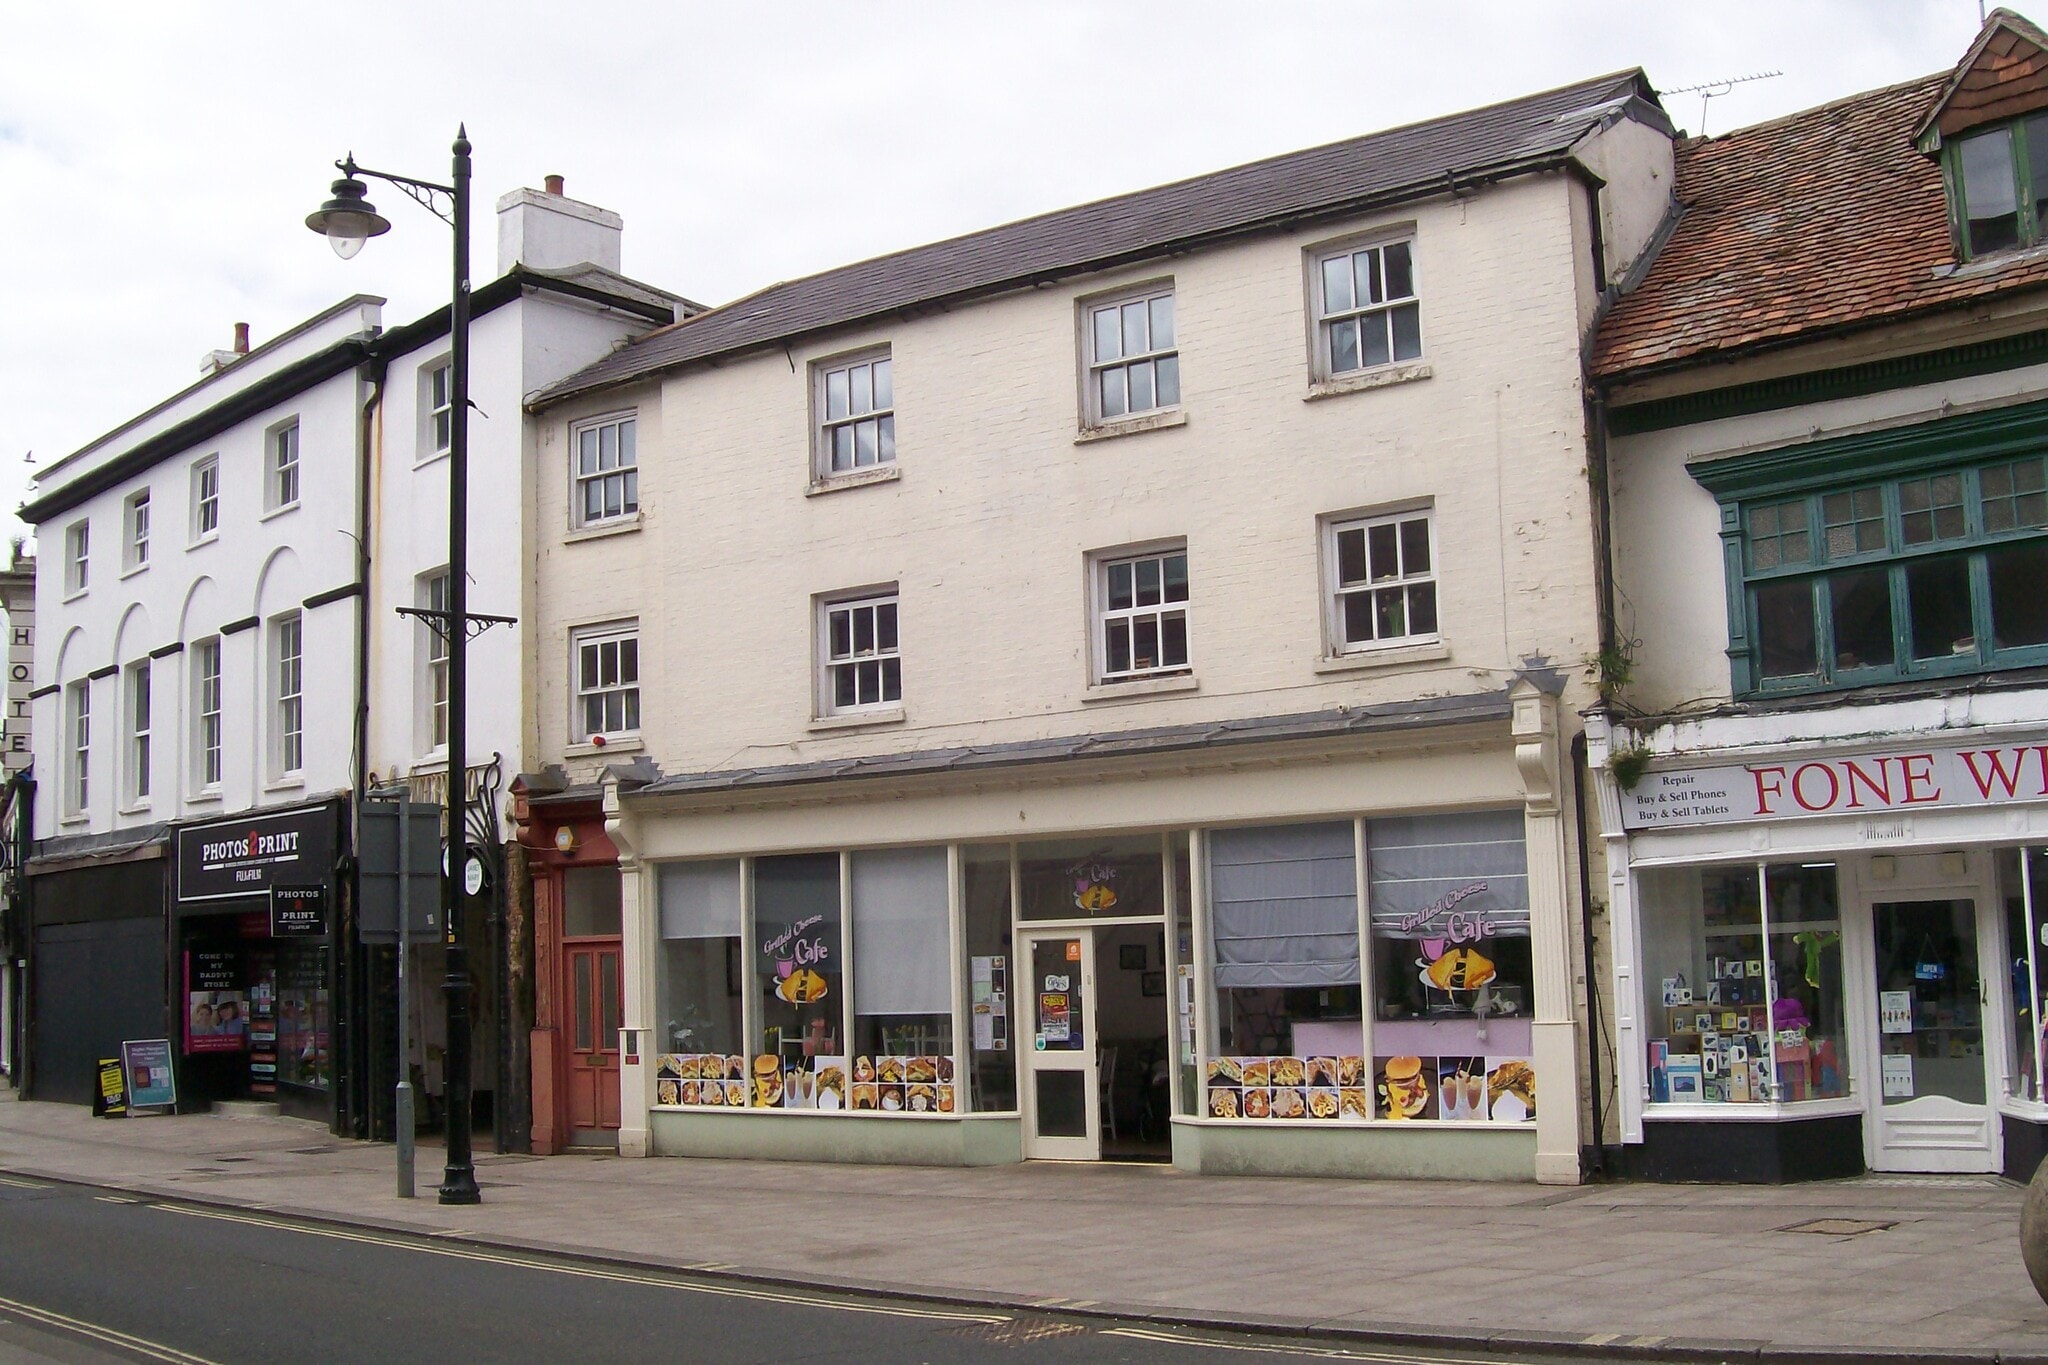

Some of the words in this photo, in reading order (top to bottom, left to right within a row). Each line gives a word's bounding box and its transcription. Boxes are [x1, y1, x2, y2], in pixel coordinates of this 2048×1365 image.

[1662, 774, 1695, 787] Repair
[1746, 753, 1941, 815] FONE
[1637, 794, 1656, 806] Buy
[1658, 793, 1667, 803] &
[1669, 791, 1688, 802] Sell
[1690, 789, 1727, 800] Phones
[1639, 809, 1658, 821] Buy
[1660, 808, 1669, 819] &
[1672, 807, 1690, 818] Sell
[1692, 804, 1730, 816] Tablets
[1090, 863, 1117, 882] Cafe
[277, 890, 319, 899] PHOTOS
[282, 911, 316, 920] PRINT
[1401, 899, 1443, 935] Grilled
[1444, 881, 1488, 909] Cheese
[763, 927, 792, 957] Grilled
[793, 914, 823, 936] Cheese
[1446, 909, 1496, 944] Cafe
[794, 937, 829, 965] Cafe
[1922, 963, 1938, 973] OPEN
